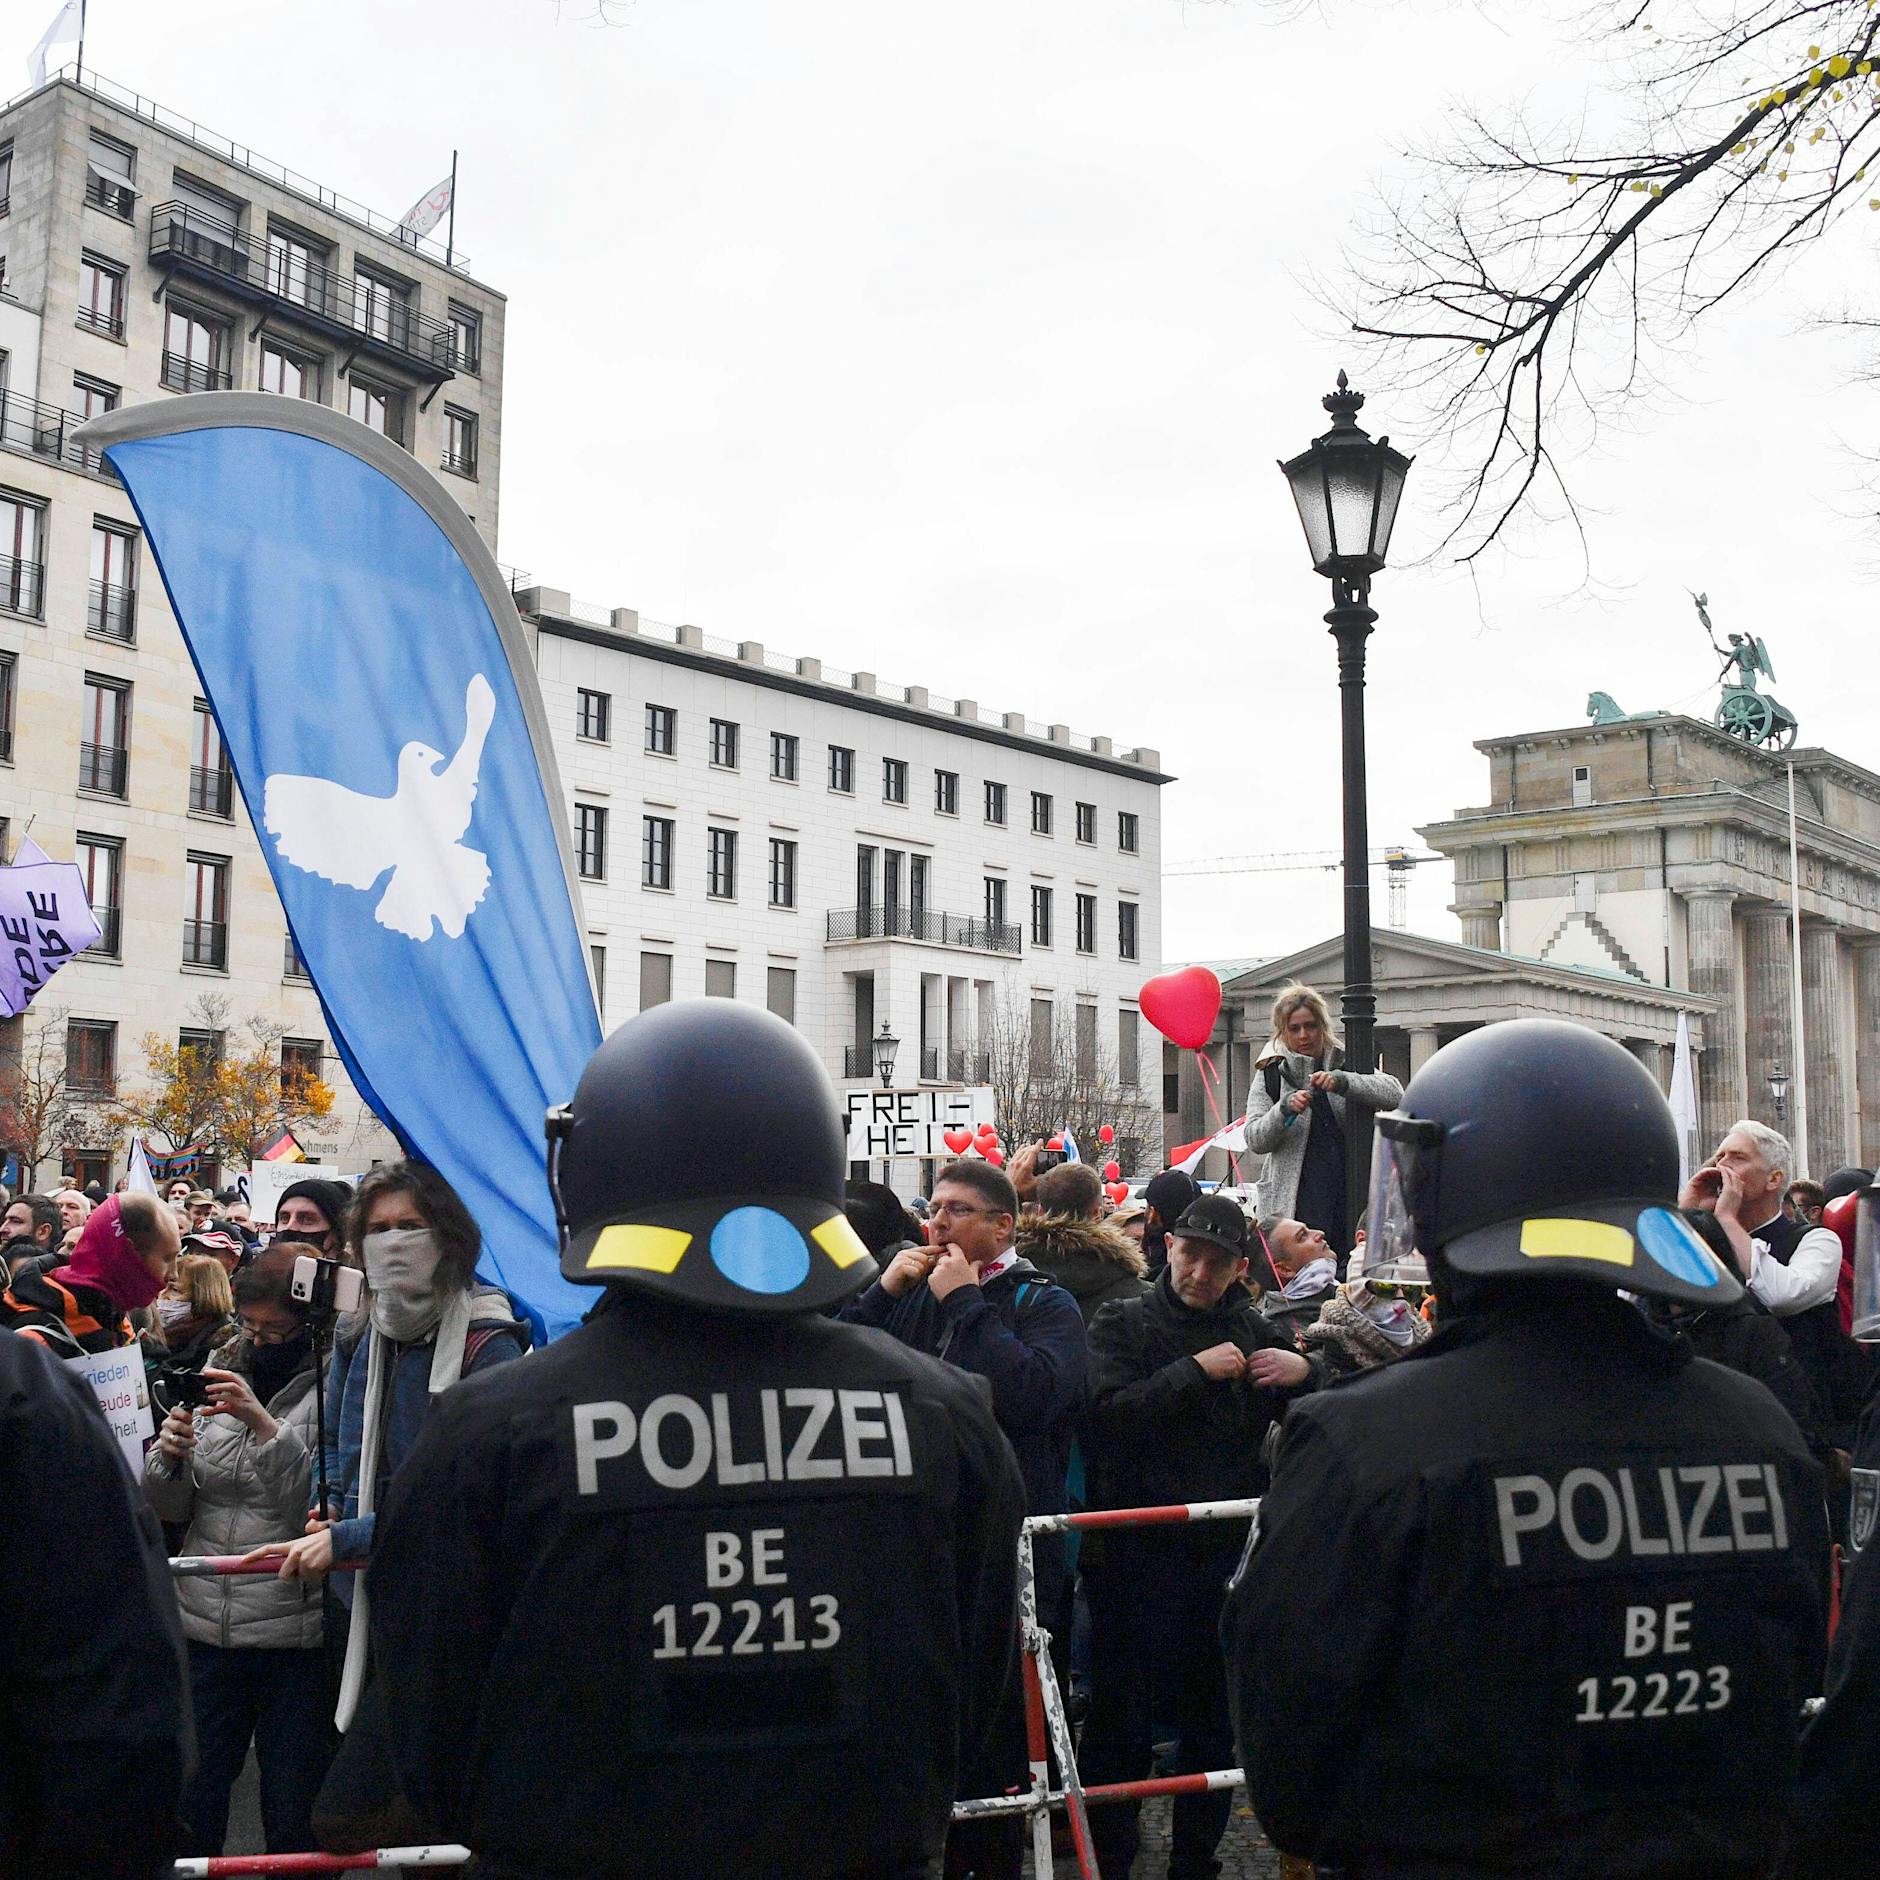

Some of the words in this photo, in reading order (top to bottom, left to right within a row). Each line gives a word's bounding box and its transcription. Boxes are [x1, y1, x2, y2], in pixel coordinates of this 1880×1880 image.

[848, 1092, 970, 1124] FREI-
[301, 1139, 338, 1153] ehmens
[867, 1123, 981, 1155] HEIT
[82, 1364, 130, 1385] rieden
[99, 1391, 132, 1412] eude
[110, 1418, 138, 1438] heit
[572, 1387, 914, 1495] POLIZEI
[1494, 1463, 1789, 1567] POLIZEI
[705, 1528, 788, 1588] BE
[652, 1594, 842, 1659] 12213
[1624, 1601, 1693, 1658] BE
[1575, 1664, 1732, 1722] 12223
